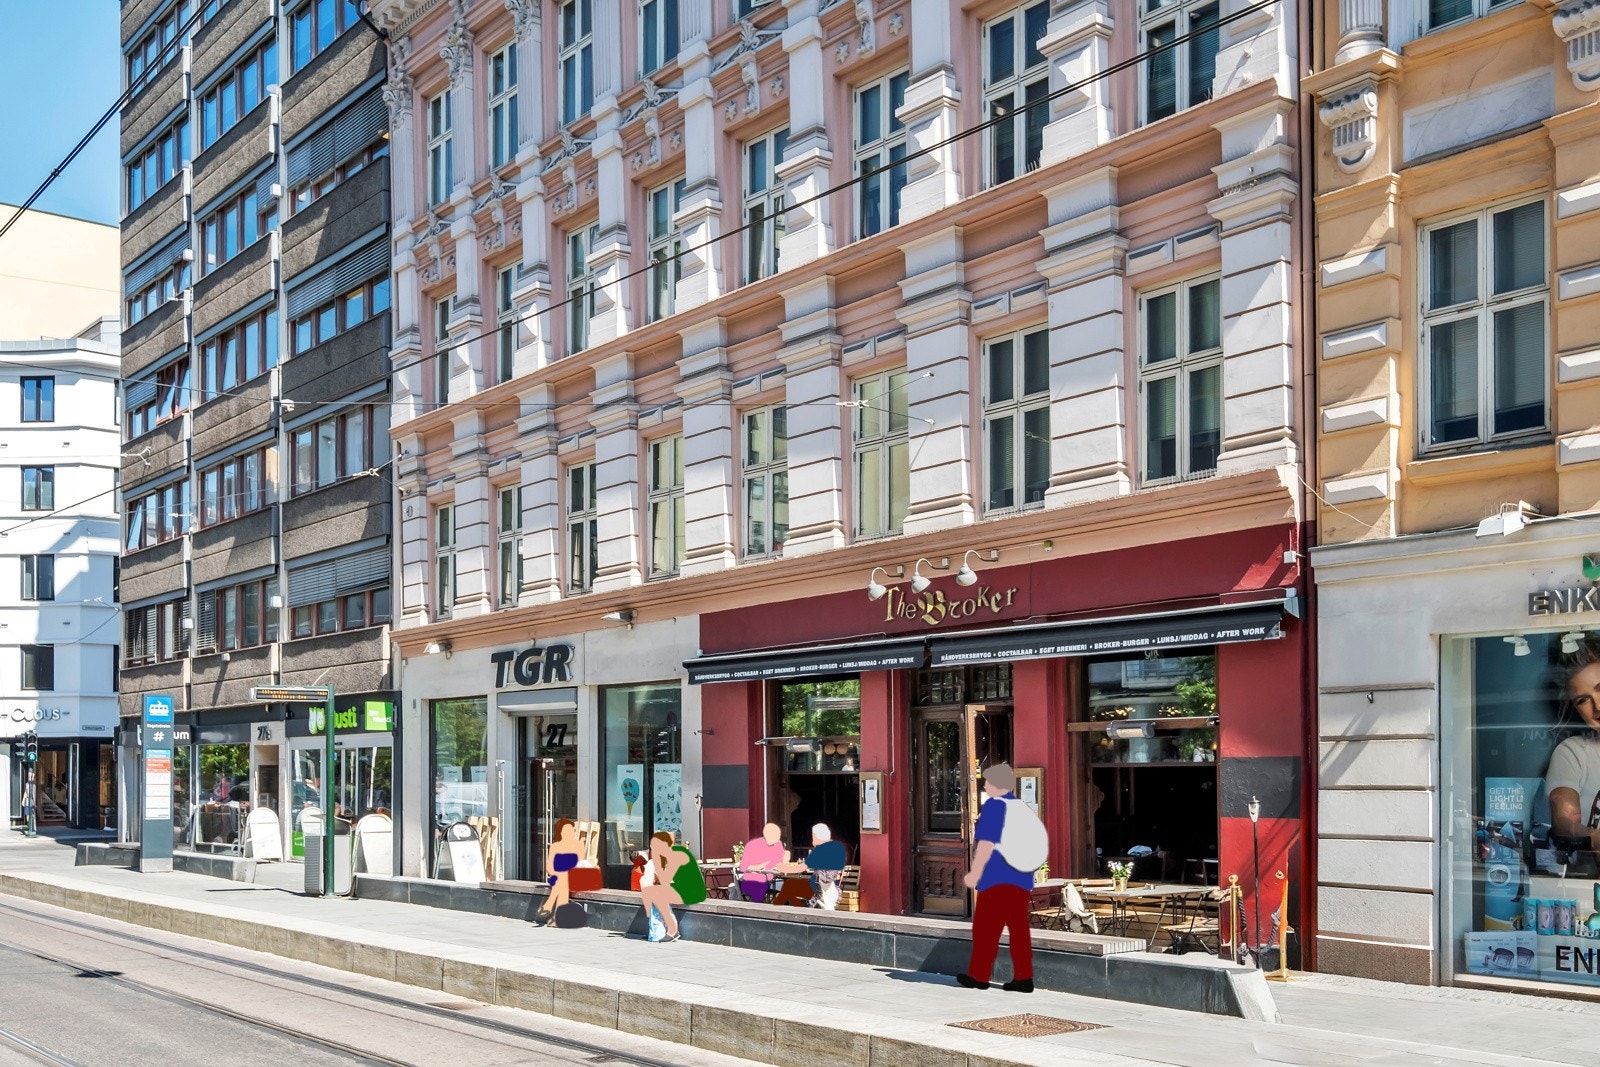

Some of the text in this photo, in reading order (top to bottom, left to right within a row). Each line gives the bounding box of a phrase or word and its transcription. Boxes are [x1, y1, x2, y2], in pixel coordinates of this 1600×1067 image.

[884, 586, 1017, 625] The Broker
[1528, 586, 1600, 616] ENK
[1039, 646, 1055, 654] EGET
[1056, 644, 1087, 653] BRENNERI
[1094, 638, 1150, 650] BROKER-BURGER
[1156, 632, 1209, 644] LUNSJ/MIDDAG
[1216, 630, 1240, 638] AFTER
[1242, 627, 1266, 636] WORK
[491, 644, 573, 689] TGR
[799, 663, 838, 671] BROKER-BURGER
[546, 723, 568, 748] 27
[1489, 787, 1522, 795] GET THE
[1489, 802, 1523, 811] FEELING
